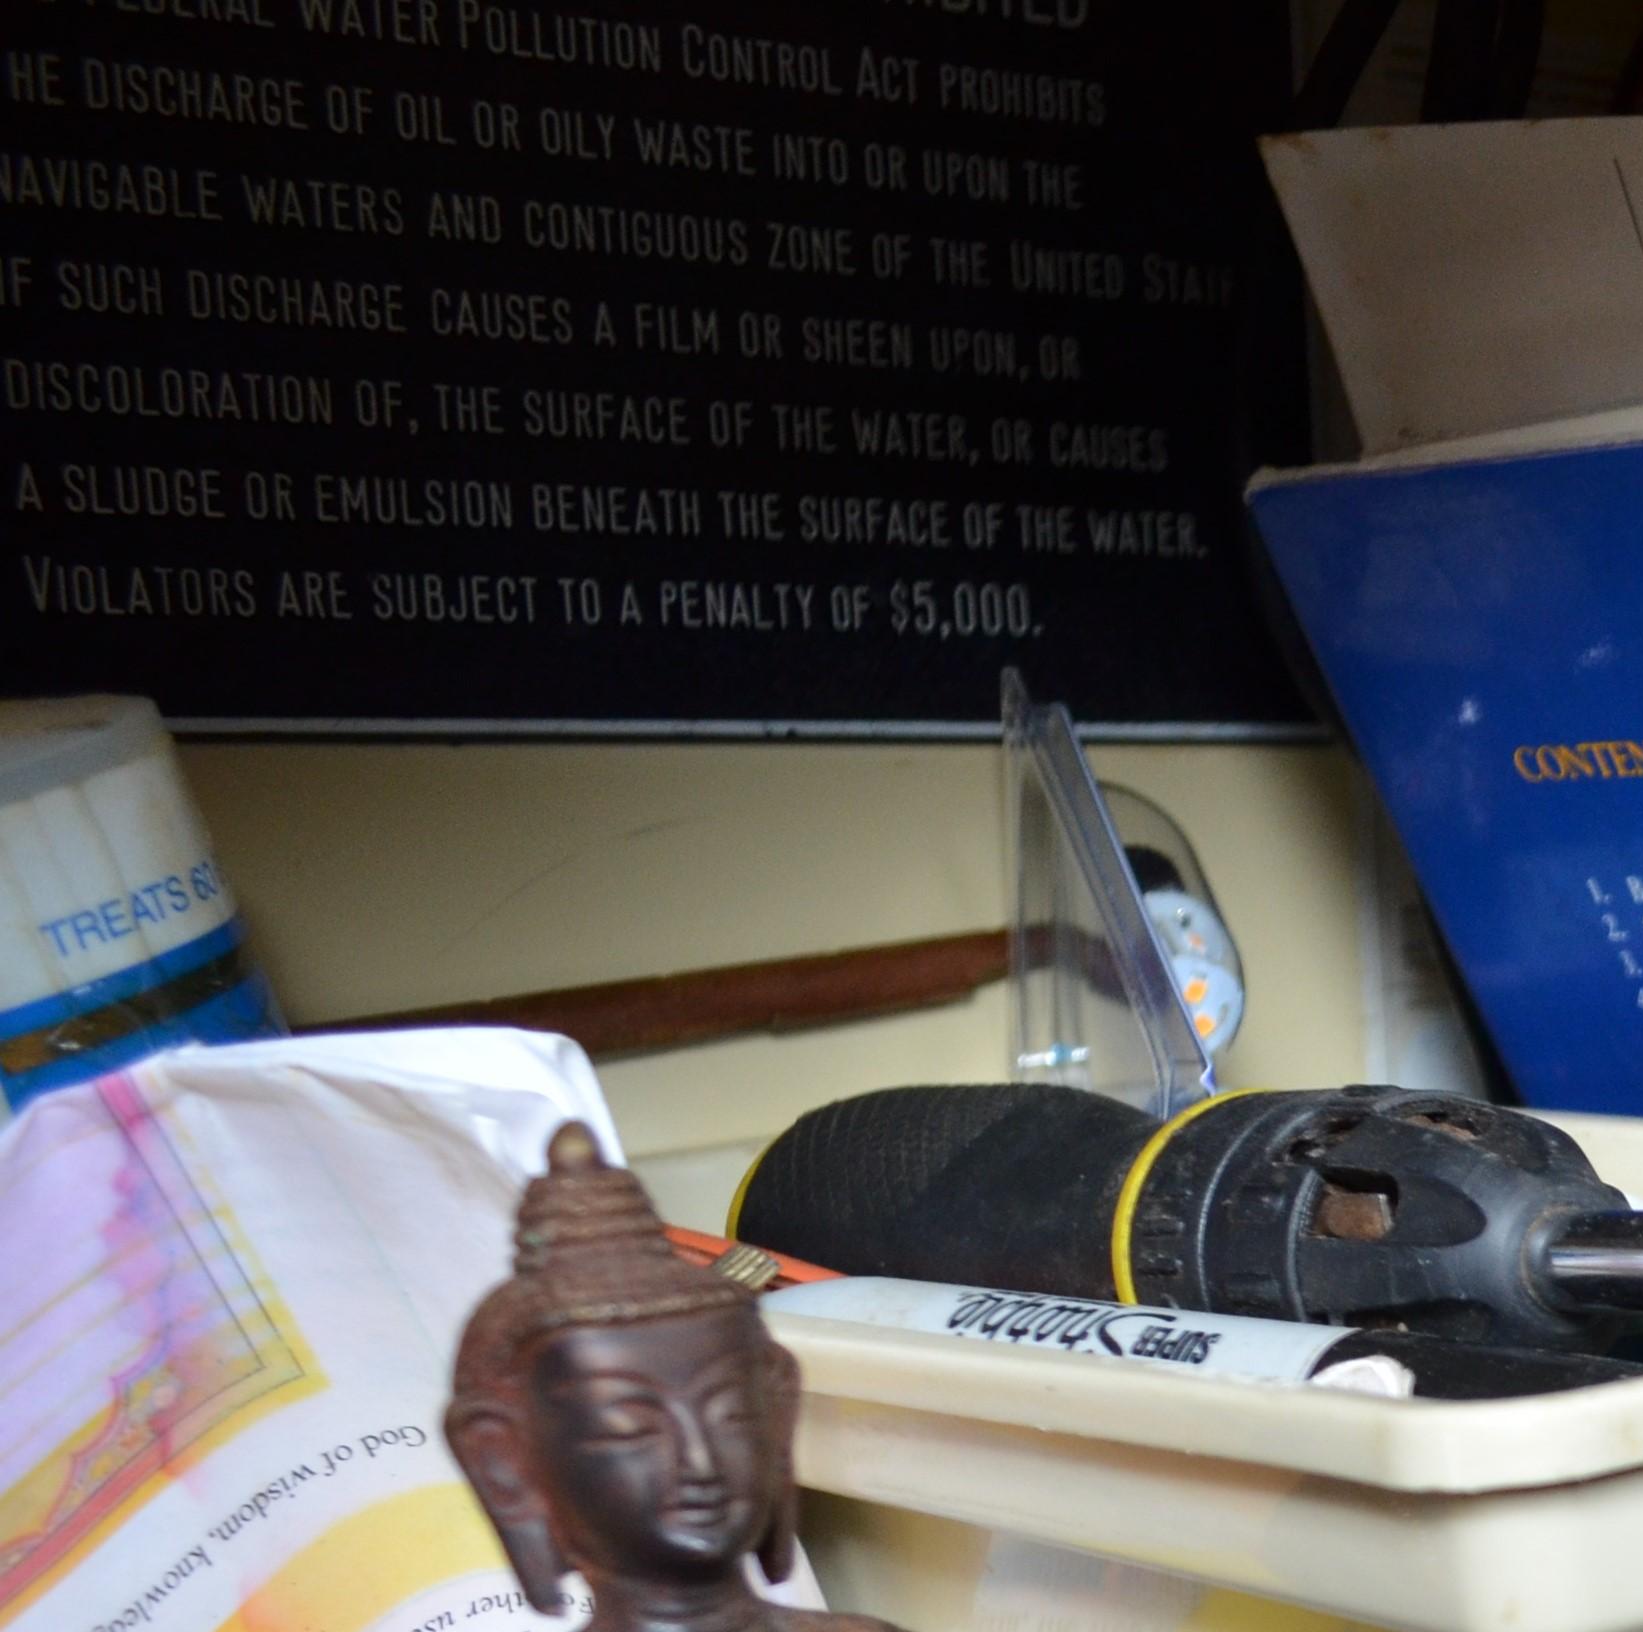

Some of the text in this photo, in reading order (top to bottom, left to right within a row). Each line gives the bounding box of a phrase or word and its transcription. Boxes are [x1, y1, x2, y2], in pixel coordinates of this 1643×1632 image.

[458, 0, 662, 73] POLLUTION
[682, 23, 843, 96] CONTROL
[856, 46, 920, 104] ACT
[939, 62, 1105, 127] PROHIBITS
[6, 50, 1084, 210] HE DISCHARGE OF OIL OR OILY WASTE INTO OR UPON THE
[242, 174, 403, 236] WATERS
[428, 192, 501, 244] AND
[524, 202, 749, 266] CONTIGUOUS
[767, 222, 857, 276] ZONE
[872, 233, 912, 282] OF
[929, 238, 991, 289] THE
[1010, 240, 1126, 300] UNITED
[58, 260, 1082, 384] SUCH DISCHARGE CAUSES A FILM OR SHEEN UPON, OR
[4, 358, 1169, 474] DISCOLORATION OF, THE SURFACE OF THE WATER, OR CAUSES
[16, 463, 1209, 561] A SLUDGE OR EMULSION BENEATH THE SURFACE OF THE WATER.
[23, 554, 1044, 641] VIOLATORS ARE SUBJECT TO A PENALTY OF $5,000.
[38, 874, 190, 958] TREATS
[1602, 912, 1628, 942] 2.
[1129, 1324, 1223, 1365] SUPER
[322, 1443, 354, 1478] of
[360, 1424, 428, 1459] God
[207, 1463, 316, 1543] wisdom,
[465, 1588, 526, 1620] ther
